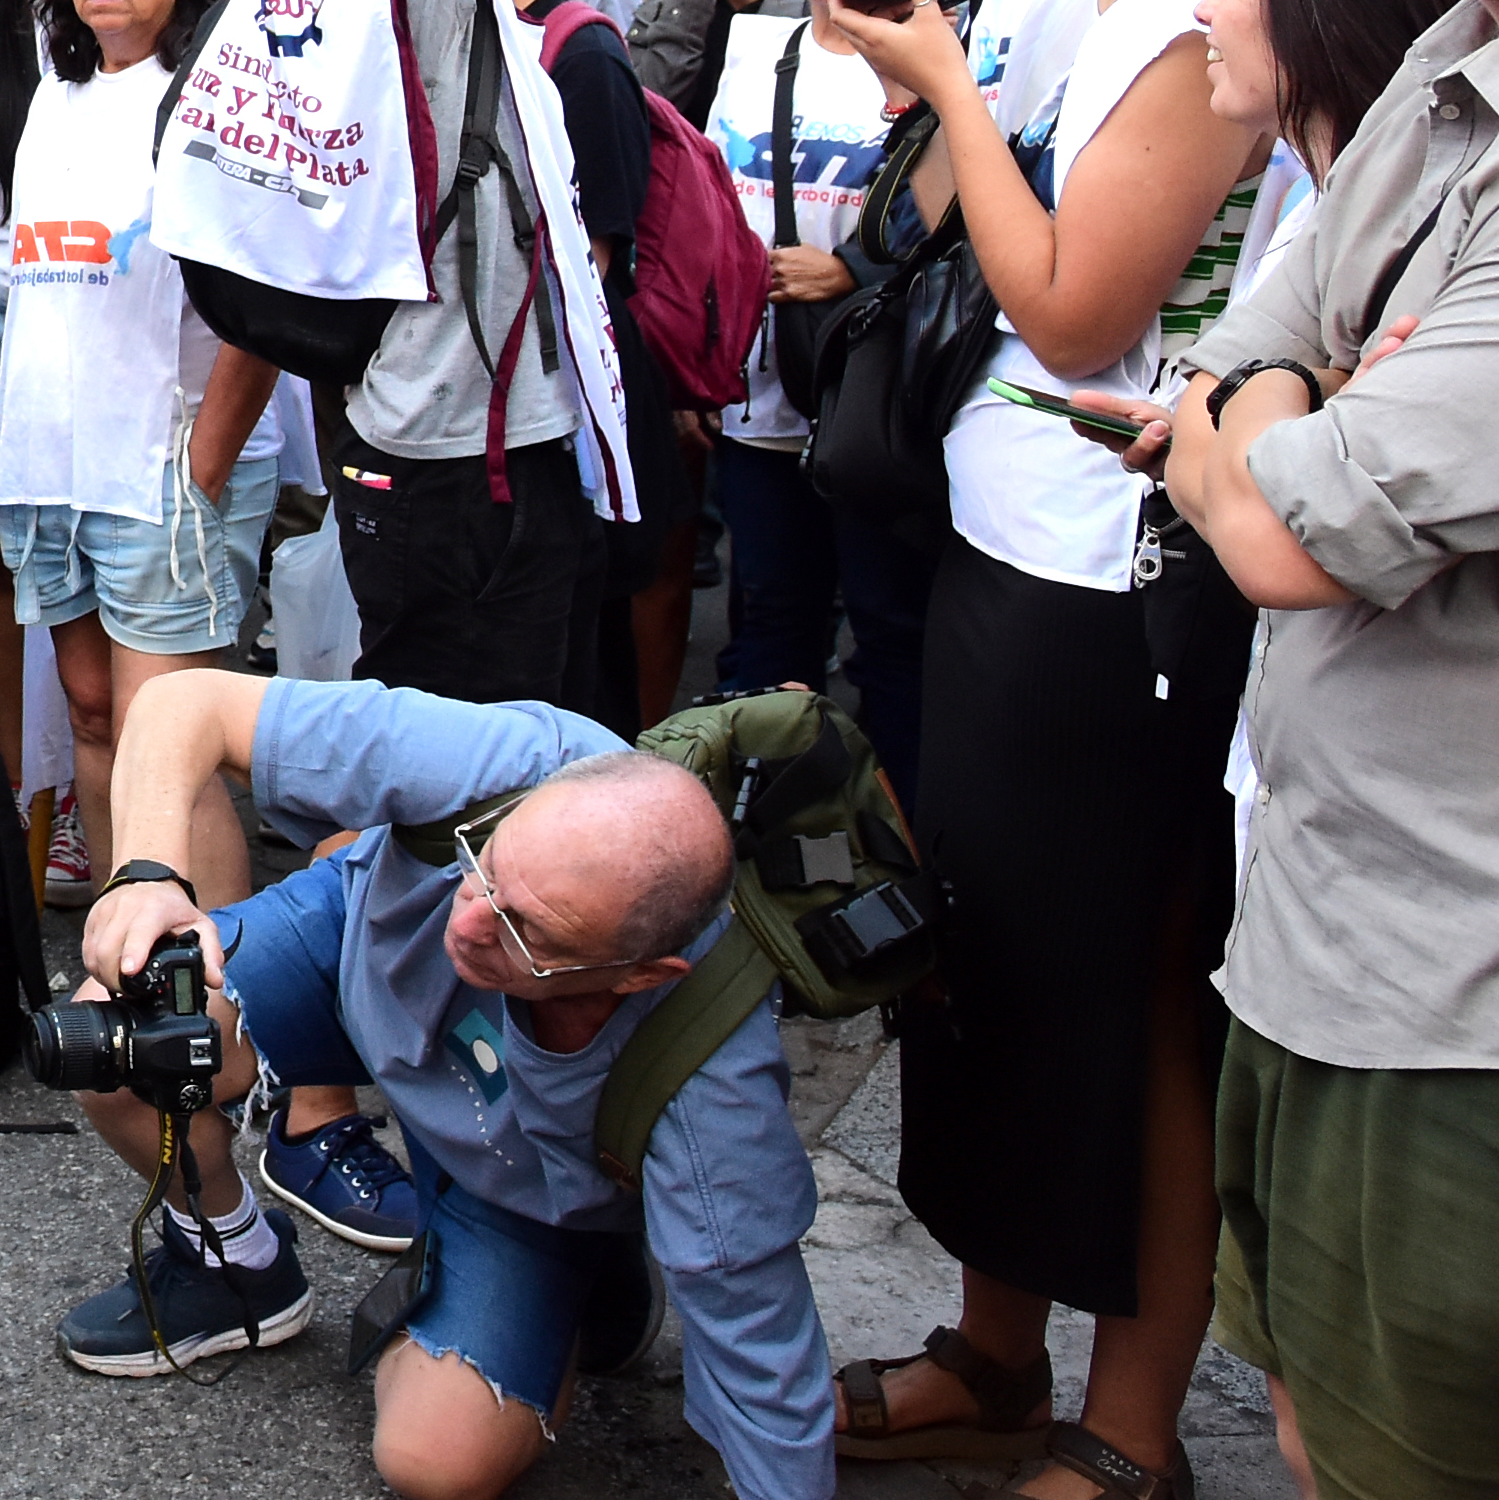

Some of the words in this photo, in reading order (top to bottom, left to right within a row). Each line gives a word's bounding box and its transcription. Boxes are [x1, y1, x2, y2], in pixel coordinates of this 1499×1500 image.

[185, 67, 222, 98] uz
[226, 85, 258, 116] y
[219, 120, 280, 162] del
[283, 142, 370, 187] Plata
